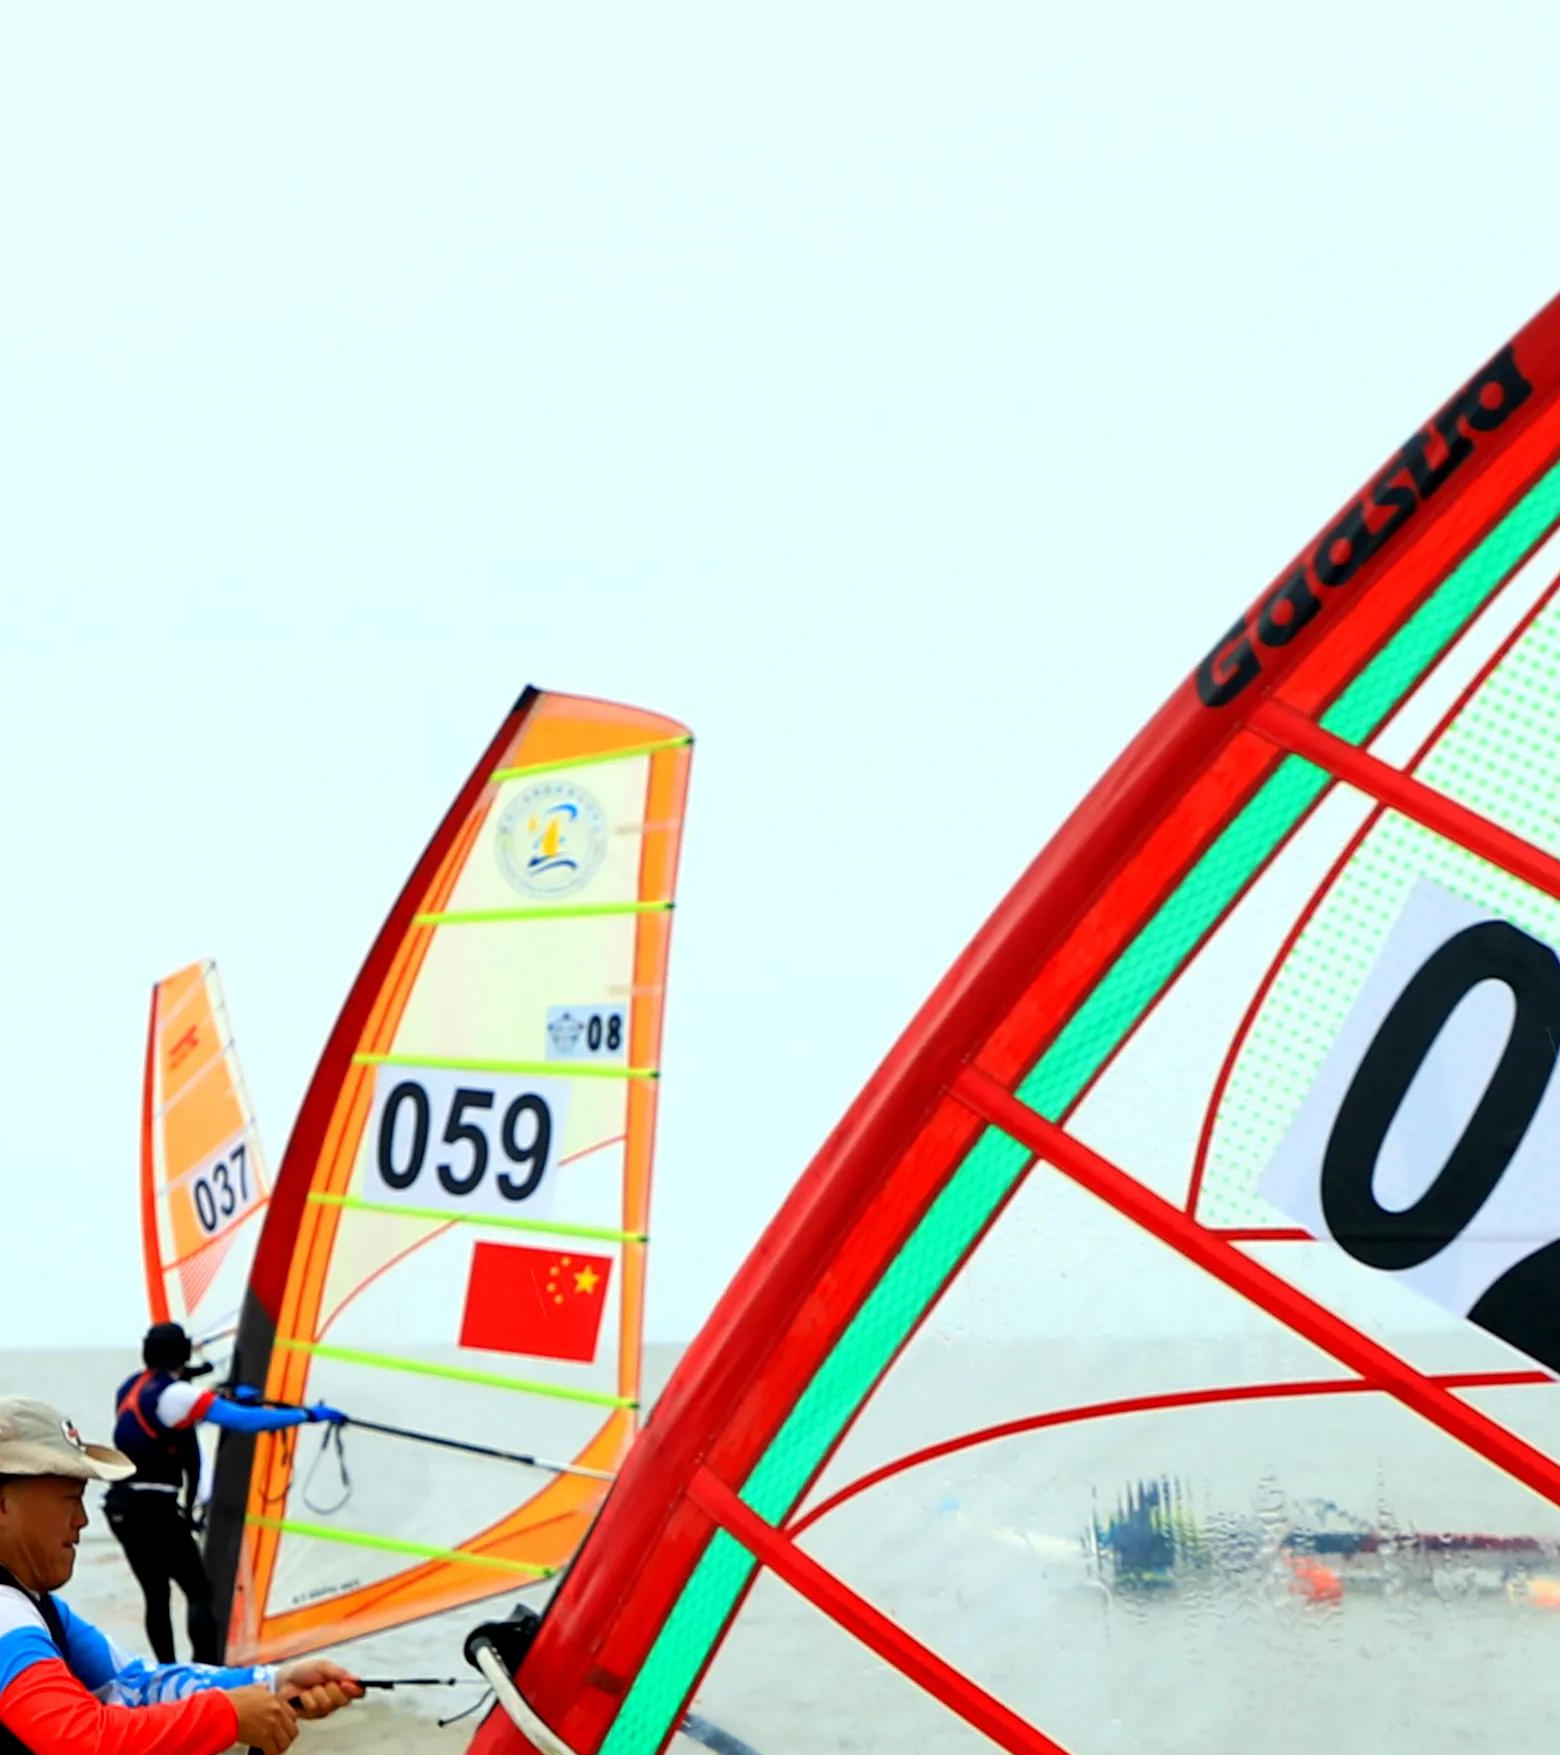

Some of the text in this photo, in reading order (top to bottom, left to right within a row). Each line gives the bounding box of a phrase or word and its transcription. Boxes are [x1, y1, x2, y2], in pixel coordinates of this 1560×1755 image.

[587, 1013, 621, 1051] 08
[377, 1080, 553, 1202] 059
[193, 1143, 250, 1232] 037
